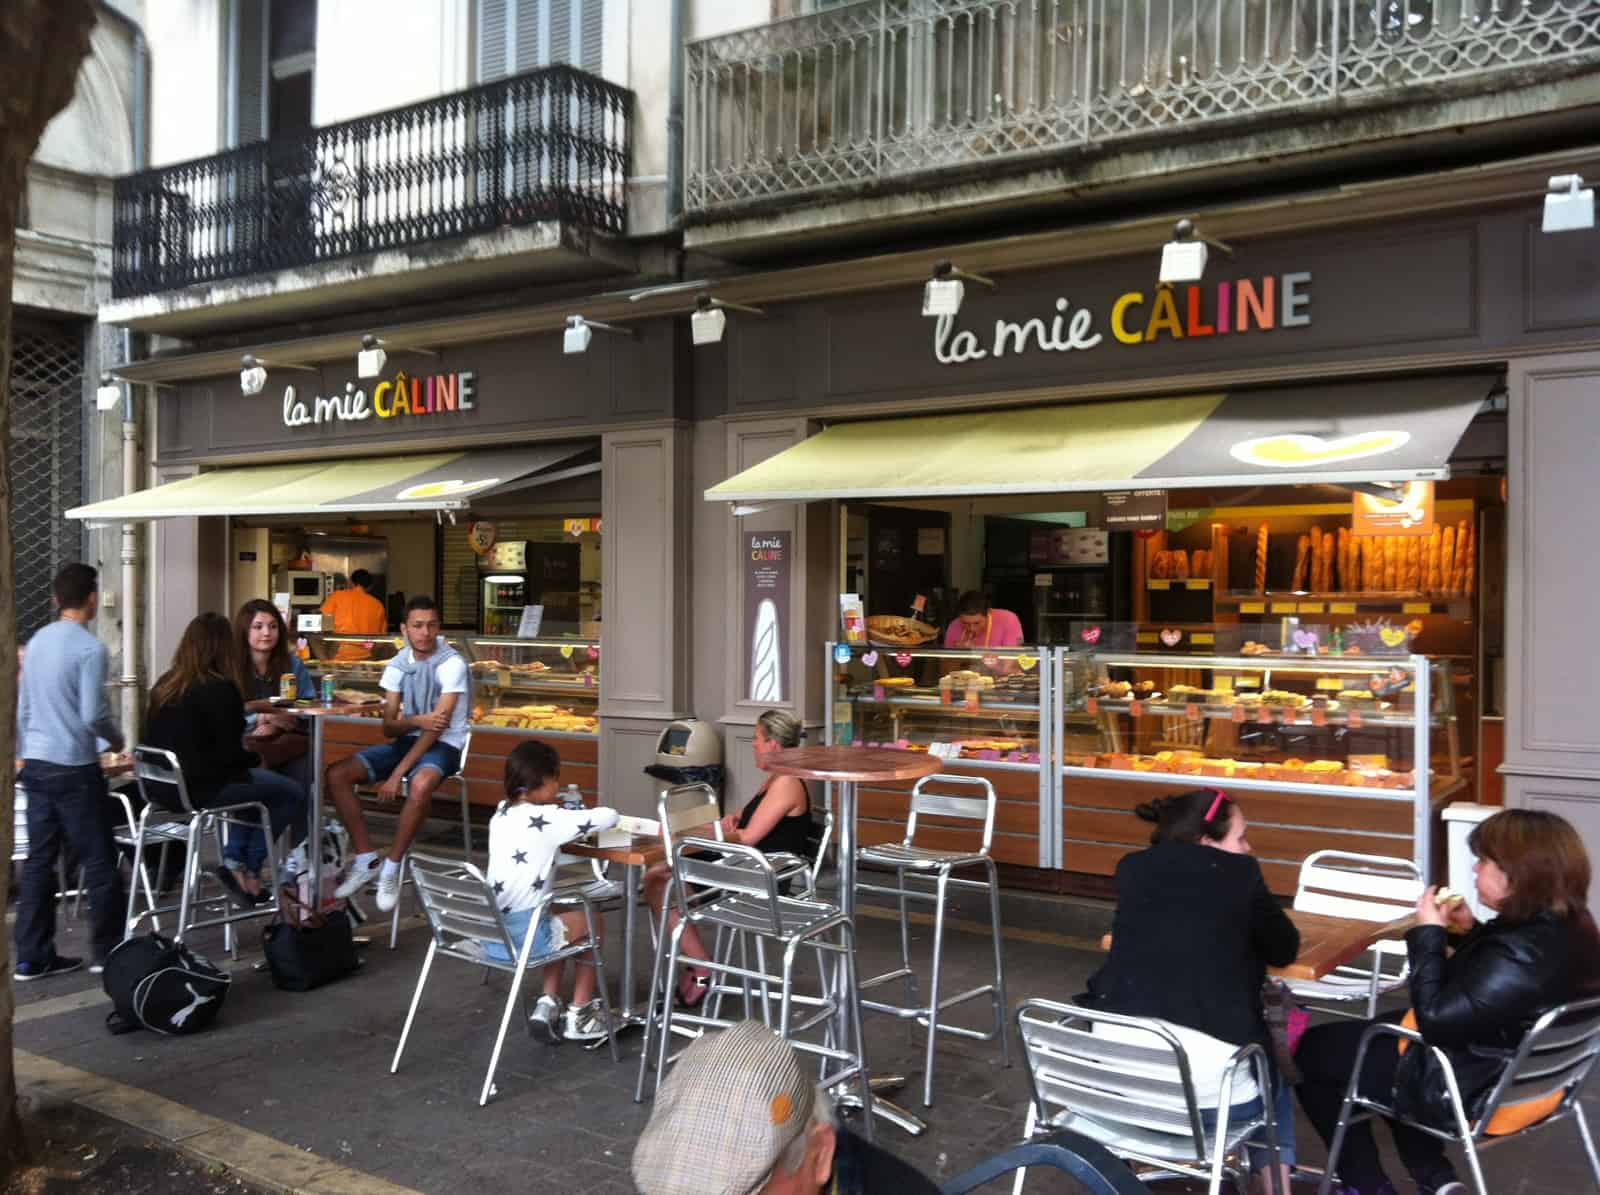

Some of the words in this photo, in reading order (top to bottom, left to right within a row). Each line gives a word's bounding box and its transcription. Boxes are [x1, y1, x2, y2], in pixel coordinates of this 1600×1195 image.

[935, 313, 986, 363] la
[993, 297, 1102, 357] mie
[1111, 272, 1312, 344] CÂLINE
[283, 384, 312, 427] la
[314, 382, 371, 424] mie
[374, 370, 474, 418] CÂLINE
[752, 536, 761, 548] la
[762, 537, 782, 548] mie
